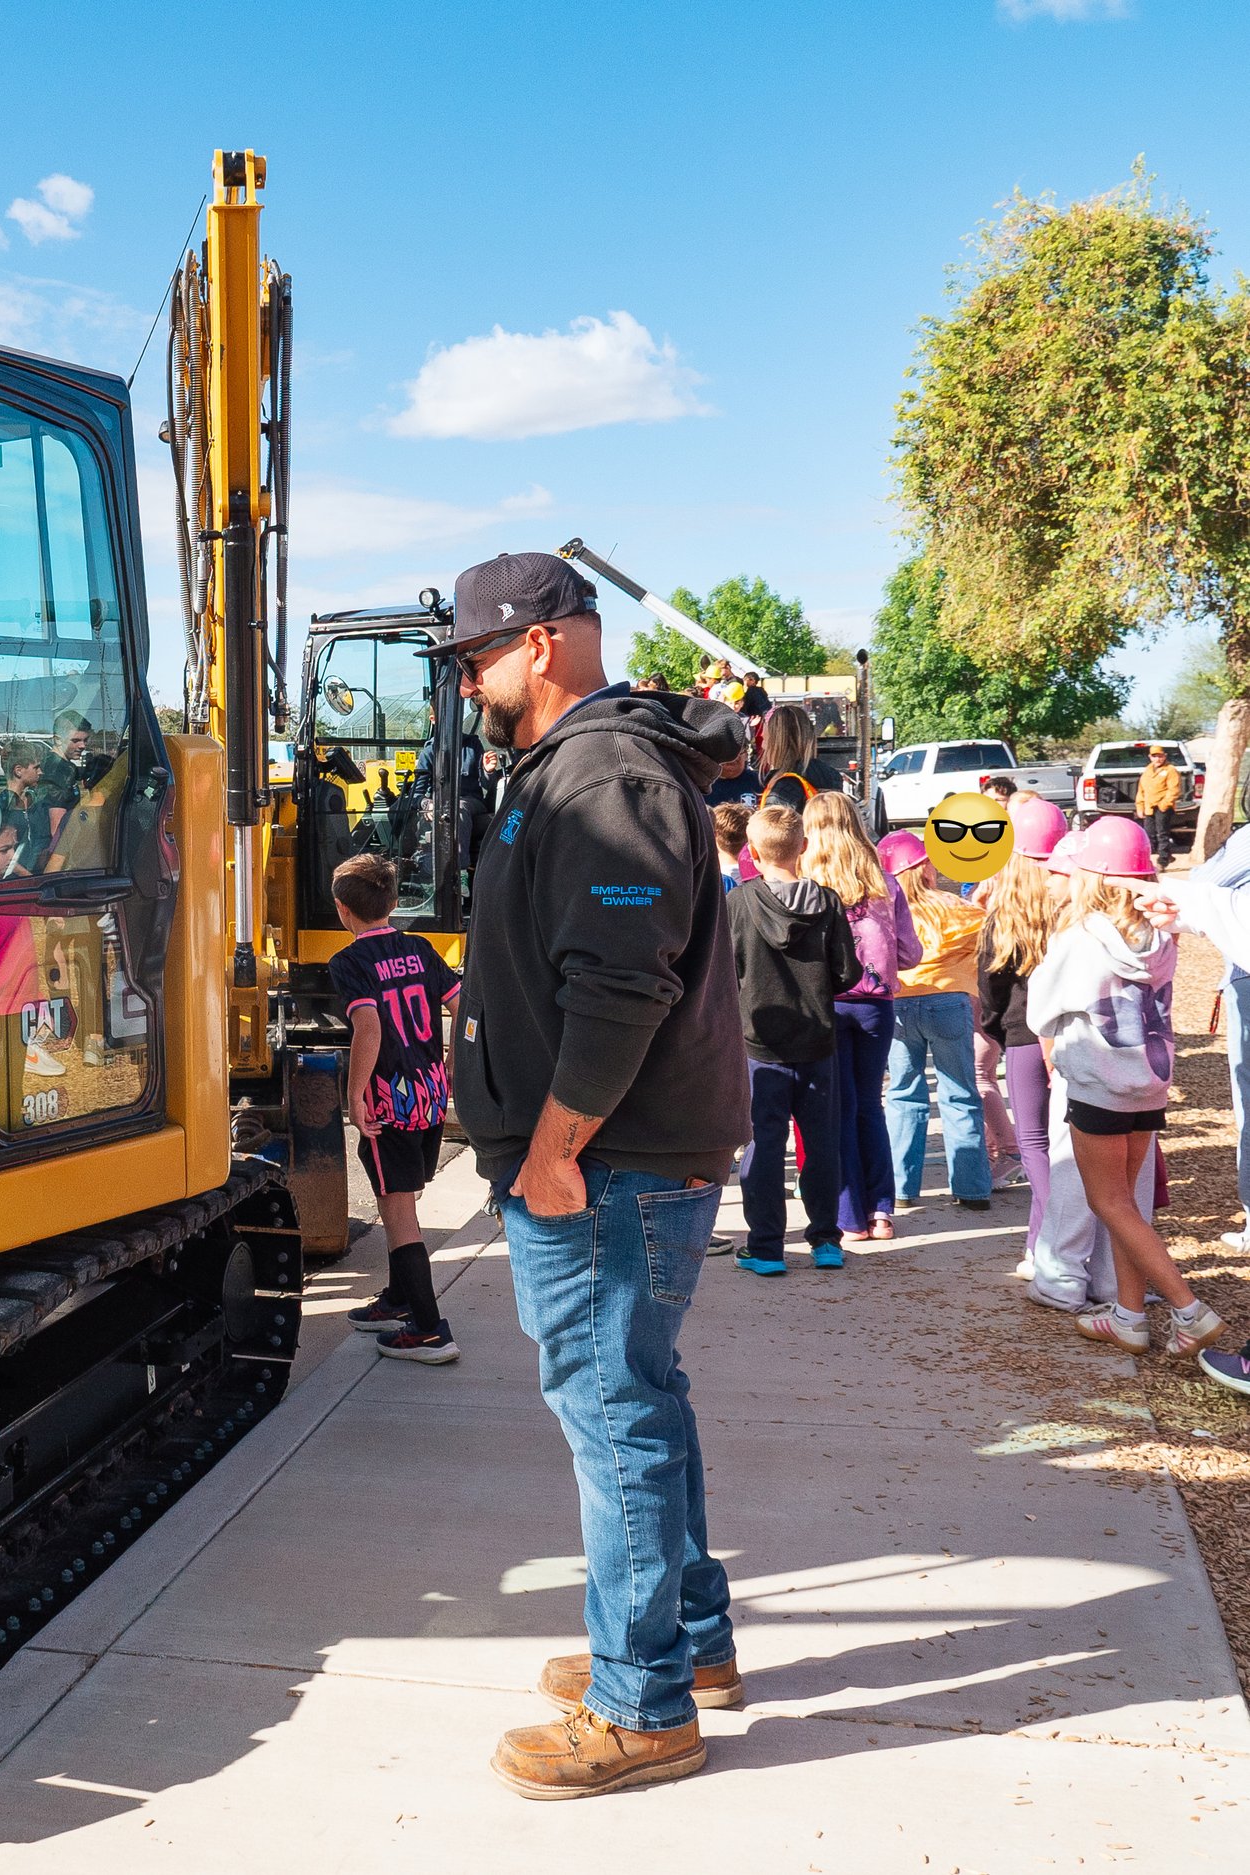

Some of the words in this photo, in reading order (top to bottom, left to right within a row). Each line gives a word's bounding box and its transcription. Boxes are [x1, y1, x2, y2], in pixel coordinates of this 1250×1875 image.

[590, 885, 662, 897] EMPLOYEE
[602, 896, 653, 906] OWNER
[21, 998, 64, 1046] CAT
[382, 984, 433, 1047] 10
[23, 1089, 60, 1125] 308
[563, 1120, 579, 1146] death
